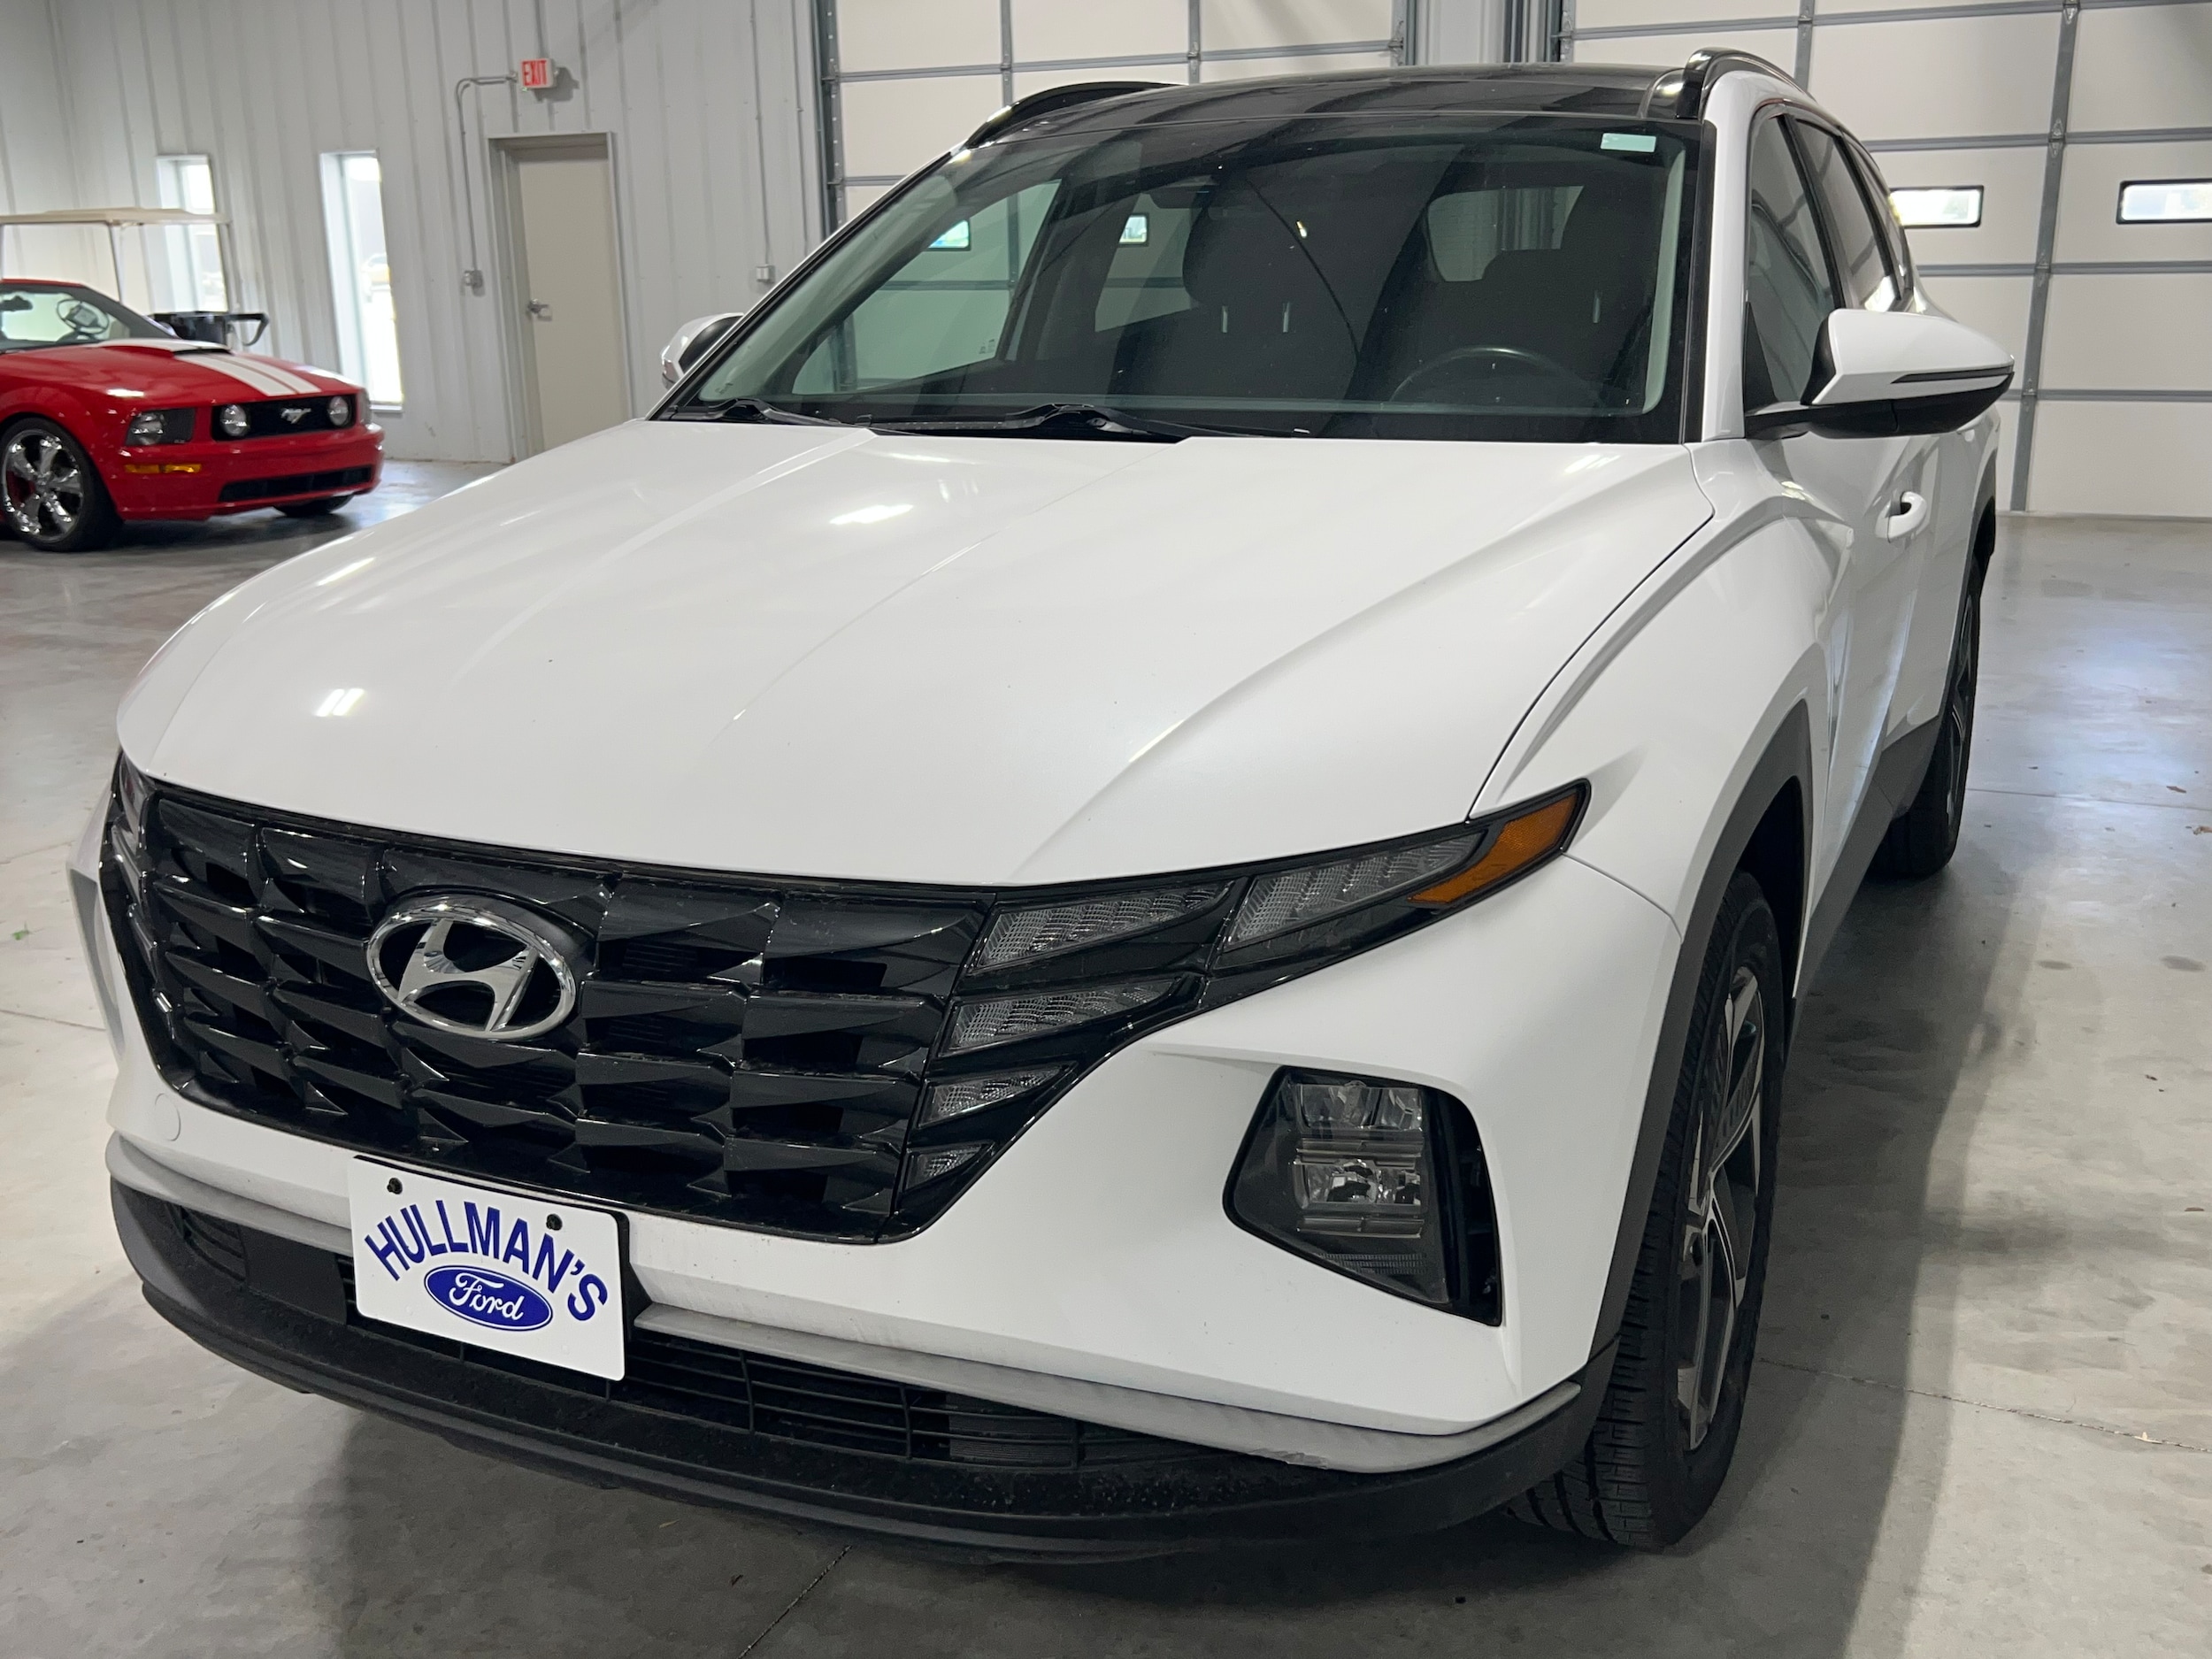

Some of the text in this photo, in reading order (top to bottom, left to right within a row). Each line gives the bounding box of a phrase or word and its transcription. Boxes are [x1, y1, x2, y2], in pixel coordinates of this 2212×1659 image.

[522, 59, 547, 86] EXIT
[364, 1200, 608, 1321] HULLMAN'S
[449, 1272, 525, 1321] Ford
